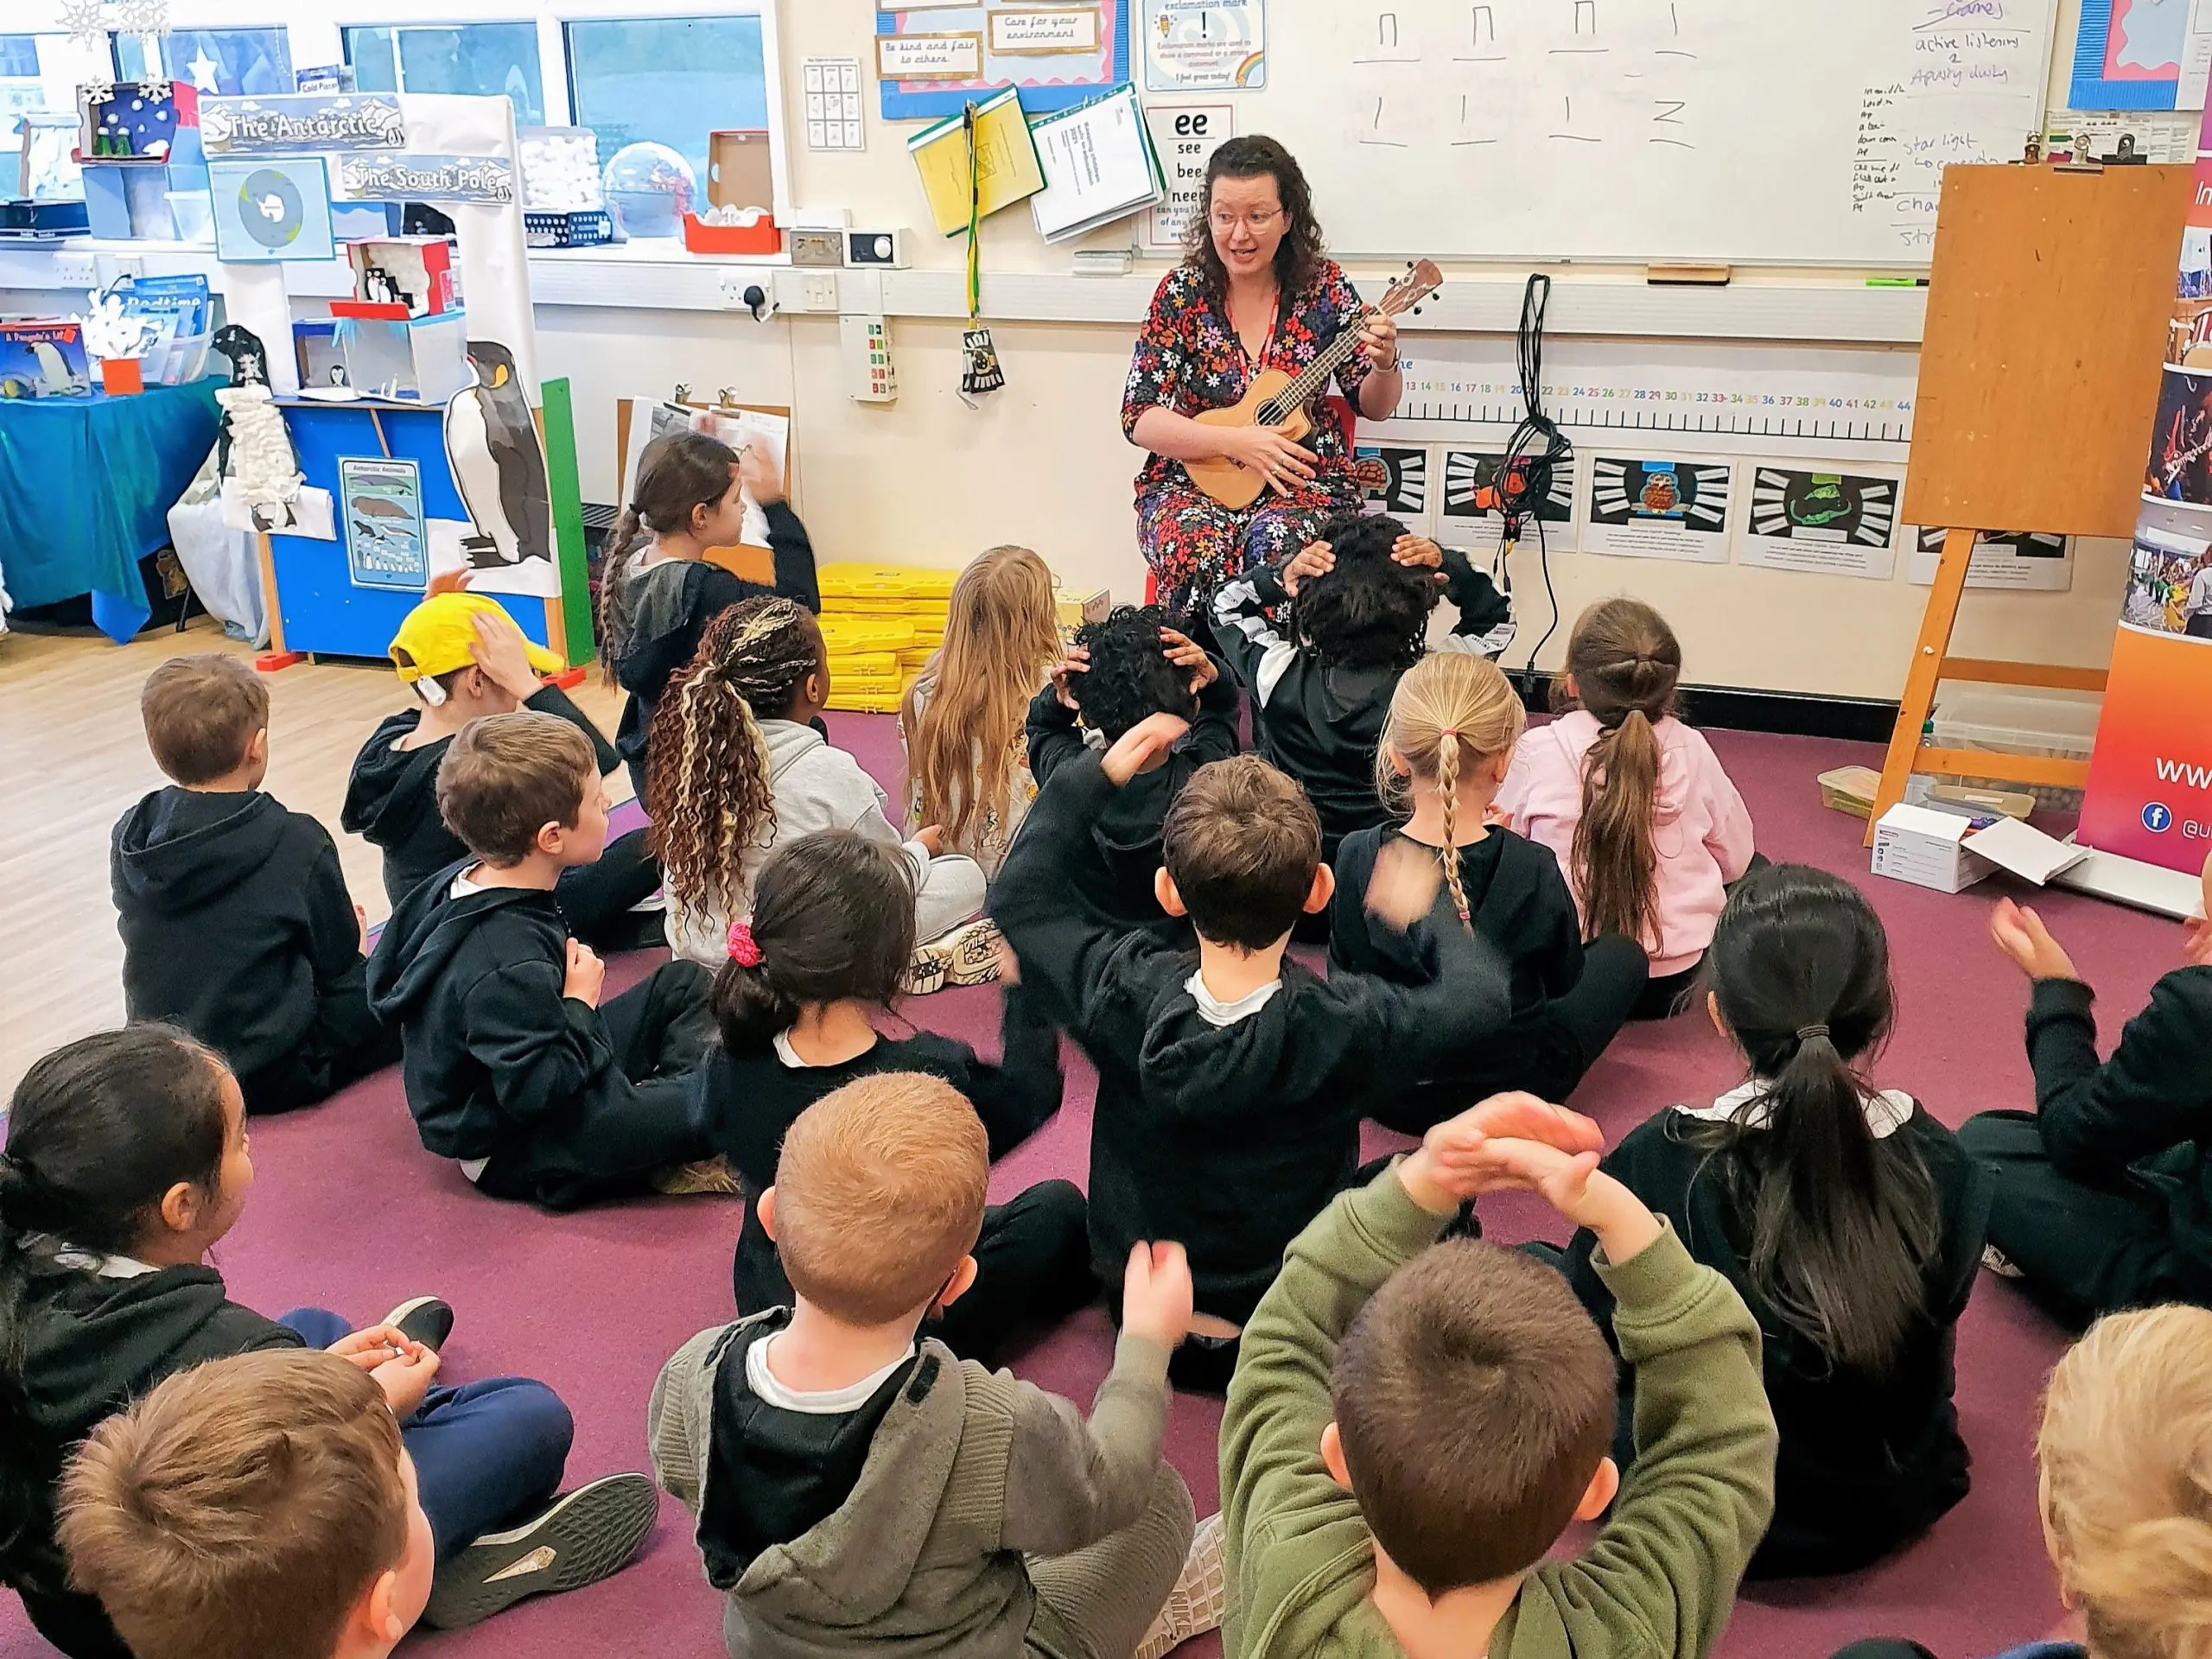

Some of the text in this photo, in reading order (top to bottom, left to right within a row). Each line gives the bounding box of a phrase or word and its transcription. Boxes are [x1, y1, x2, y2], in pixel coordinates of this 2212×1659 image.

[1005, 16, 1077, 28] Care for your
[1007, 29, 1075, 40] environment
[885, 40, 975, 52] Be kind and fair
[901, 55, 912, 64] to
[229, 111, 378, 137] The Antarctic
[1175, 115, 1207, 135] ee
[1178, 144, 1201, 154] see
[1178, 162, 1202, 178] bee
[356, 166, 496, 190] The South Pole
[1160, 217, 1169, 226] of
[1406, 382, 1416, 391] 13
[1421, 382, 1431, 391] 14
[1451, 383, 1461, 391] 16
[1465, 384, 1476, 393] 17
[1480, 384, 1491, 393] 18
[1510, 385, 1522, 394] 20
[1541, 386, 1553, 395] 22
[1573, 387, 1585, 396] 24
[1587, 387, 1599, 397] 25
[1602, 388, 1614, 397] 26
[1634, 390, 1645, 399] 28
[1649, 391, 1661, 399] 29
[1664, 391, 1677, 401] 30
[1696, 392, 1708, 402] 32
[1731, 393, 1743, 404] 34
[1762, 395, 1775, 404] 36
[1780, 396, 1793, 406] 37
[1796, 397, 1809, 406] 38
[1828, 398, 1842, 408] 40
[1846, 399, 1858, 408] 41
[1863, 400, 1876, 409] 42
[1897, 401, 1910, 410] 44
[353, 464, 380, 473] Antarctic
